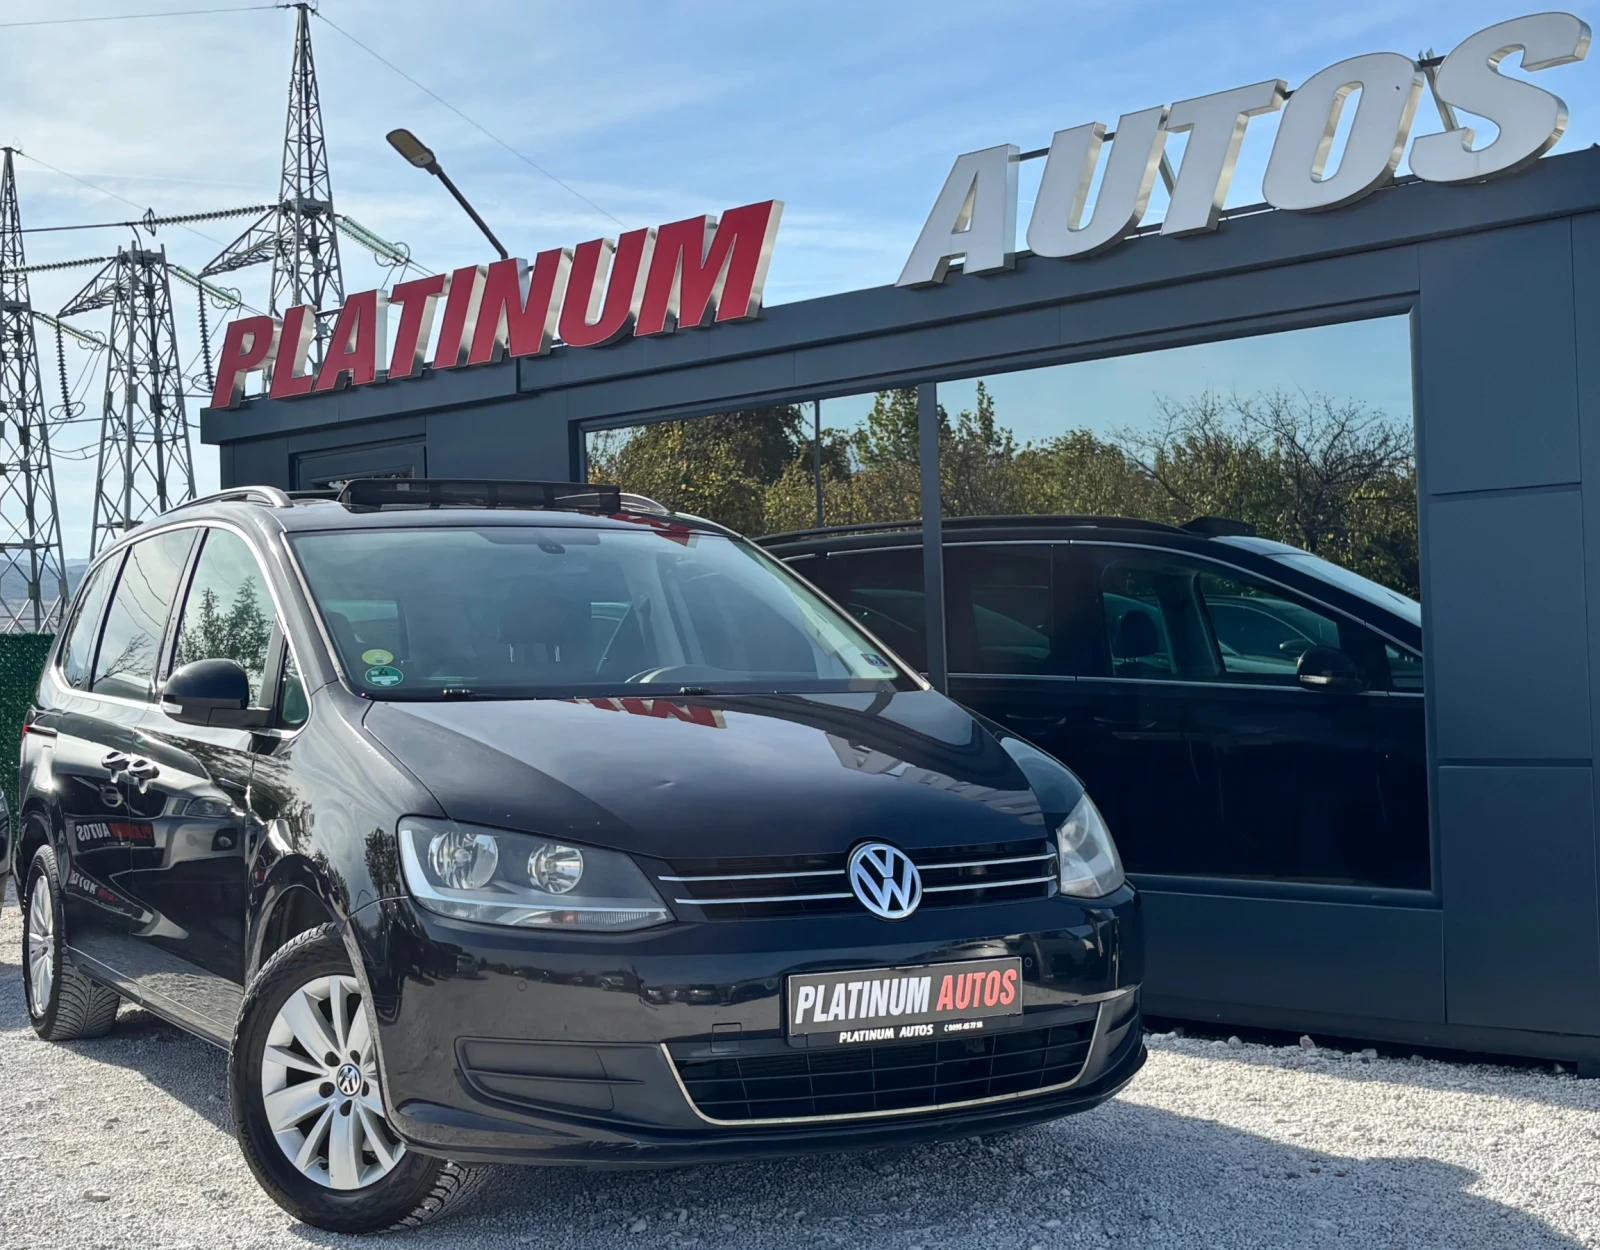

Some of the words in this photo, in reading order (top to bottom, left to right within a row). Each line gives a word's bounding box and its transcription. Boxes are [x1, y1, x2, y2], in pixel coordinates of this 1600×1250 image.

[210, 199, 784, 410] PLATINUM
[895, 12, 1592, 289] AUTOS
[795, 976, 932, 1025] PLATINUM
[936, 968, 1018, 1012] AUTOS
[838, 1027, 895, 1044] PLATINUM
[899, 1023, 935, 1038] AUTOS
